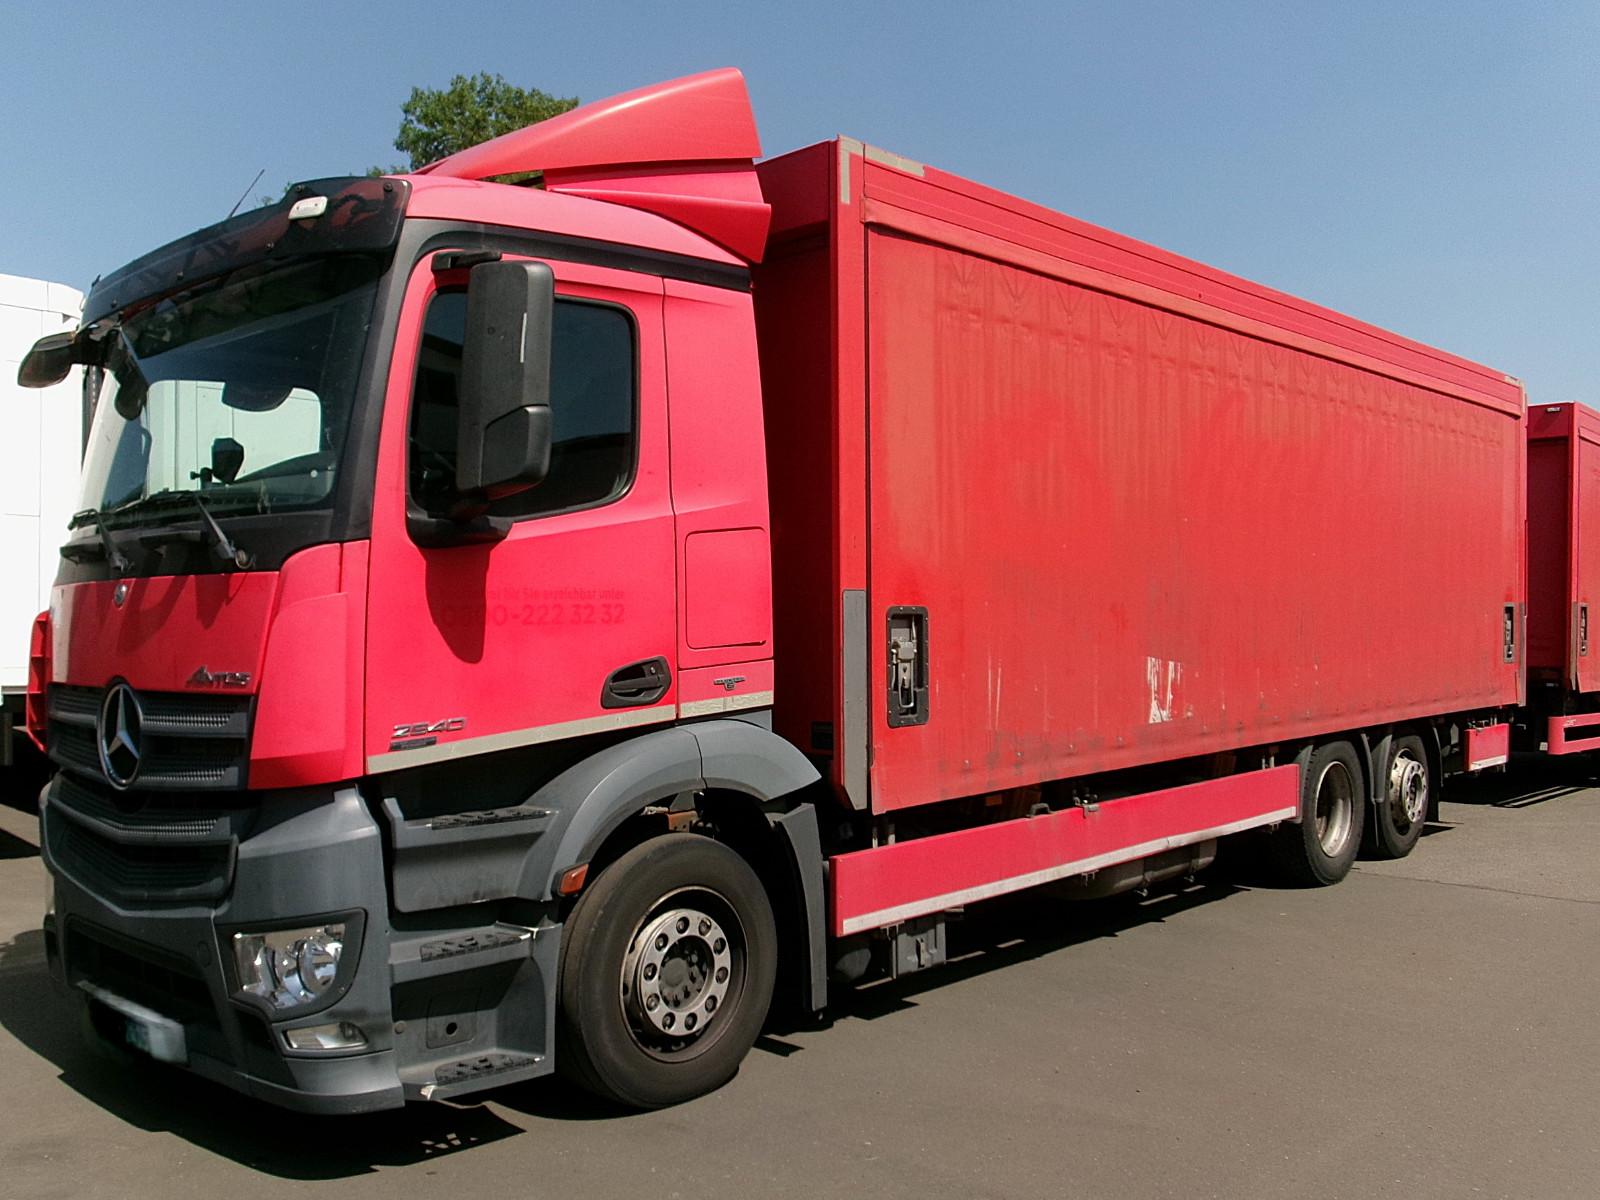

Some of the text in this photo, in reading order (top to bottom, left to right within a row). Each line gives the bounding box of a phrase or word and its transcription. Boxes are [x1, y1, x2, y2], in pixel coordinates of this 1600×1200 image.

[569, 602, 596, 625] 32
[600, 602, 625, 625] 32
[391, 716, 467, 738] 2540
